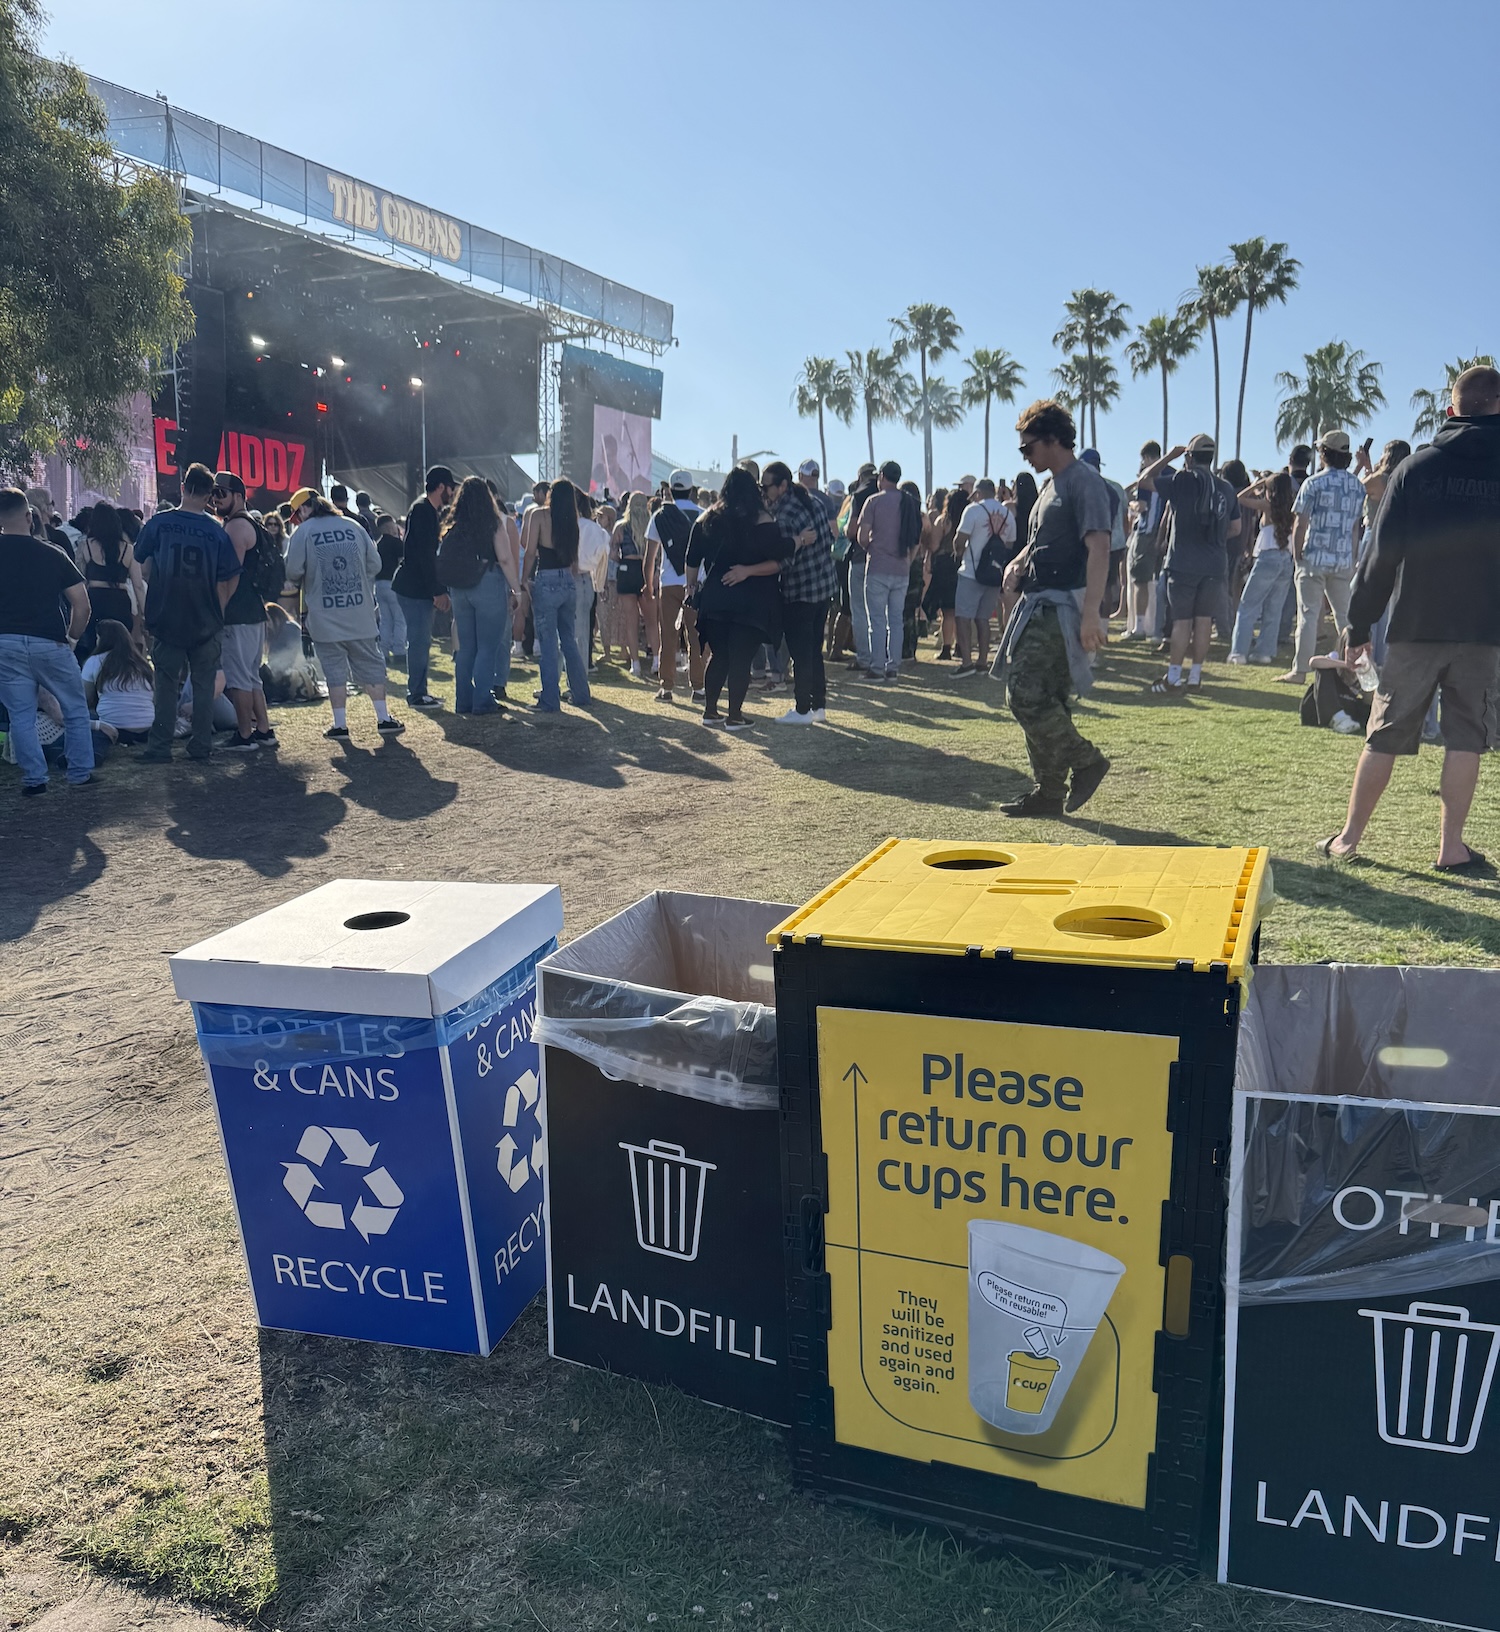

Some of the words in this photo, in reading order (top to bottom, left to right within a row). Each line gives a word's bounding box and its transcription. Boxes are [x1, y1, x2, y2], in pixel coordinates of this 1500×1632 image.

[327, 174, 378, 232] THE
[381, 195, 461, 263] GREENS
[216, 430, 306, 494] UDDZ
[312, 528, 356, 546] ZEDS
[170, 542, 203, 577] 19
[322, 593, 364, 609] DEAD
[477, 1042, 494, 1077] &
[495, 1001, 537, 1059] CAN
[253, 1058, 282, 1092] &
[290, 1062, 400, 1101] CANS
[922, 1053, 1084, 1111] Please
[879, 1106, 1027, 1158] return
[1042, 1129, 1134, 1170] our
[877, 1159, 987, 1210] cups
[1001, 1163, 1129, 1225] here.
[494, 1201, 545, 1285] RECY
[272, 1253, 448, 1304] RECYCLE
[986, 1279, 1012, 1298] Please
[1014, 1293, 1041, 1308] return
[1042, 1302, 1058, 1313] me.
[568, 1273, 777, 1365] LANDFILL
[892, 1308, 920, 1324] will
[925, 1311, 945, 1328] be
[898, 1290, 938, 1313] They
[995, 1292, 1008, 1305] I'm
[1009, 1300, 1048, 1319] reusable!
[881, 1340, 909, 1354] and
[914, 1346, 952, 1363] used
[883, 1324, 954, 1347] sanitized
[879, 1356, 920, 1372] again
[925, 1365, 955, 1380] and
[893, 1375, 940, 1394] again.
